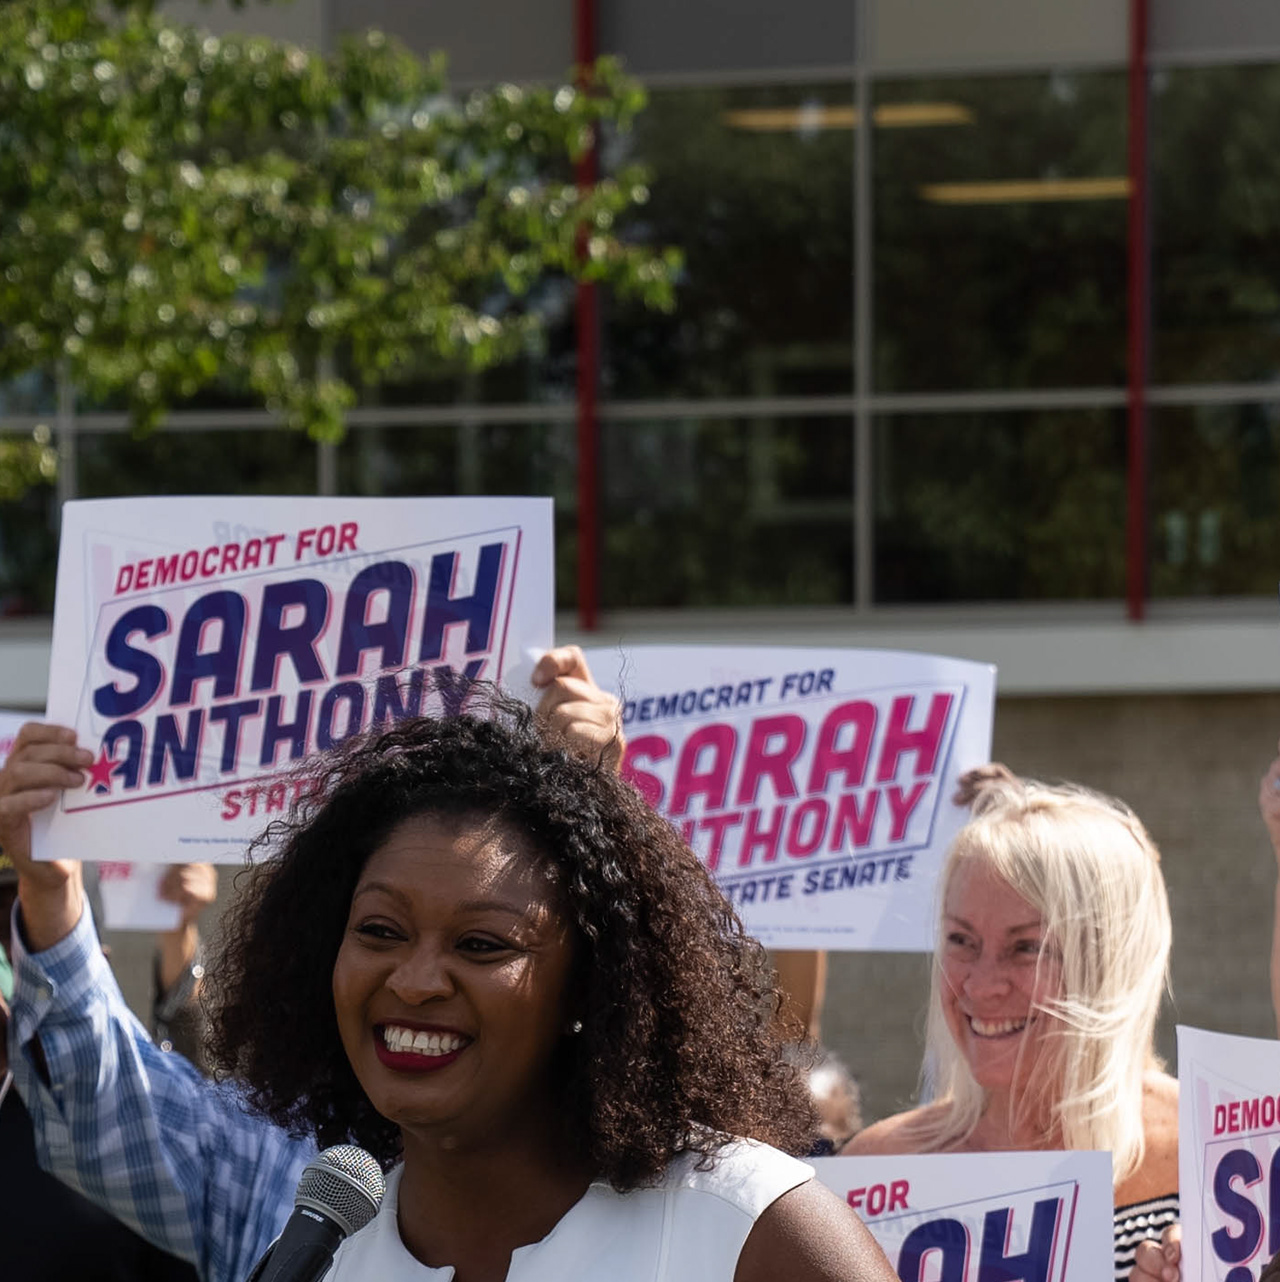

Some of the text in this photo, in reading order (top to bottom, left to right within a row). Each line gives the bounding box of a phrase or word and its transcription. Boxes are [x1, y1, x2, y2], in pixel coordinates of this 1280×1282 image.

[115, 522, 359, 596] DEMOCRAT FOR
[93, 542, 509, 719] SARAH
[623, 668, 835, 724] DEMOCRAT FOR
[620, 693, 954, 816] SARAH
[681, 781, 931, 872] THONY
[724, 855, 914, 903] TATE SENATE
[847, 1179, 910, 1216] FOR
